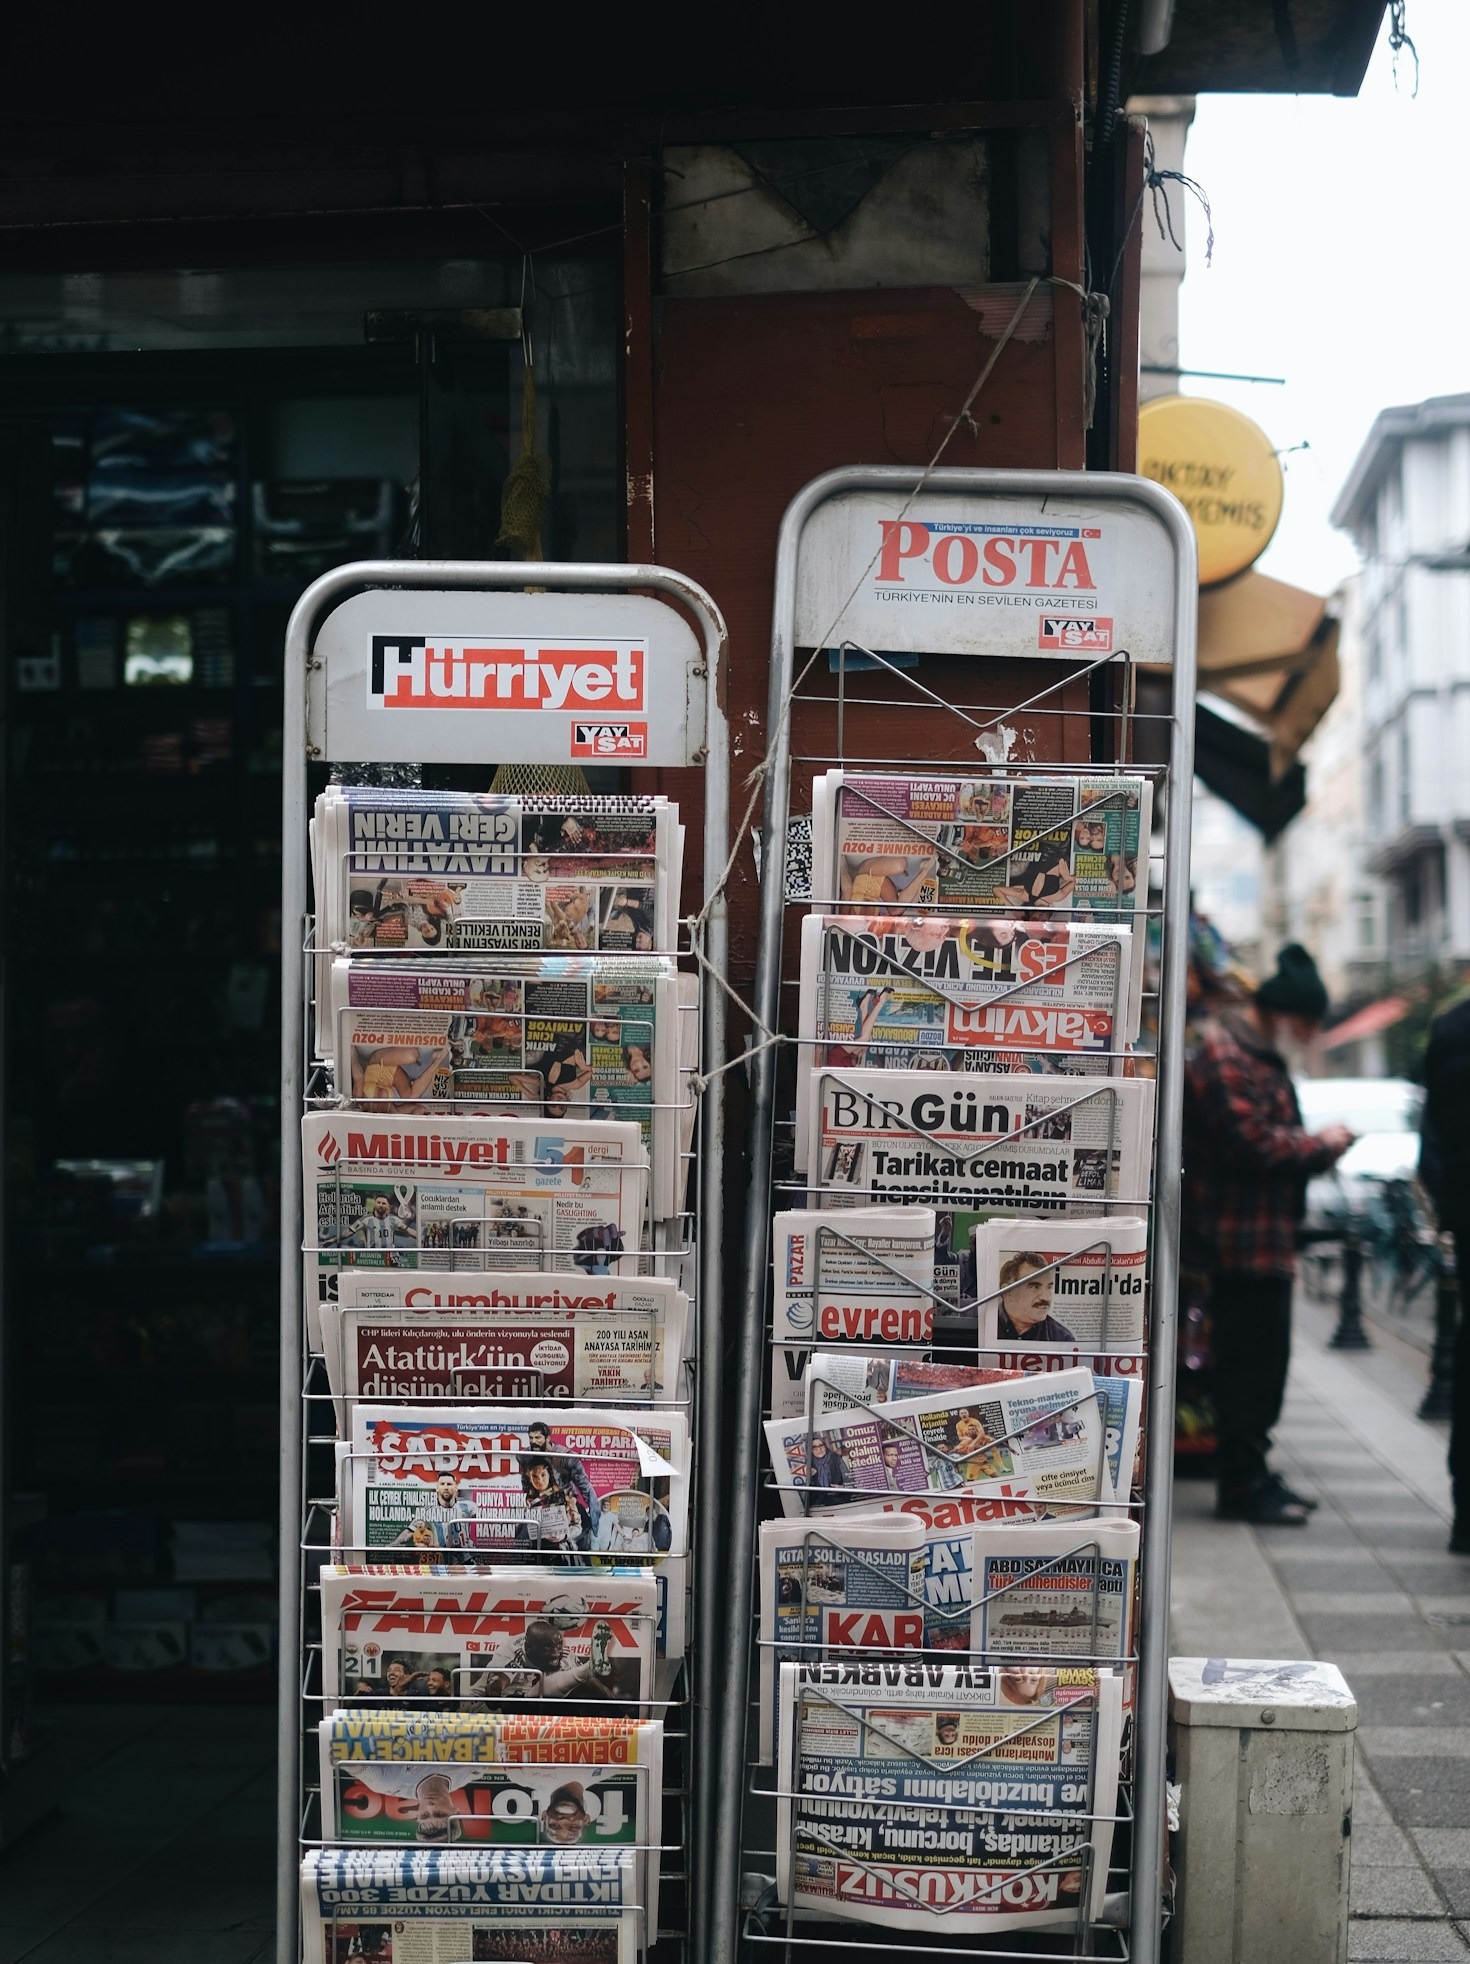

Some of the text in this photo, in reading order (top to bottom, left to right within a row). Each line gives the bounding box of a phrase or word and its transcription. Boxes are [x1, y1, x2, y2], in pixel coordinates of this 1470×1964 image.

[934, 523, 972, 533] Türkiye'yi
[984, 525, 1018, 534] insanları
[1019, 527, 1035, 536] çok
[1035, 528, 1074, 537] seviyoruz
[875, 520, 1097, 590] POSTA
[875, 590, 1098, 609] TÜRKİYE'NİN EN SEVİLEN GAZETESİ
[1046, 620, 1093, 636] YAY
[1064, 630, 1108, 646] SAT
[383, 646, 637, 709] Hürriyet
[578, 726, 625, 743] YAY
[598, 736, 642, 753] SAT
[842, 842, 874, 854] POZU
[354, 840, 515, 874] HAYATIMI
[502, 925, 540, 937] RENKLİ
[953, 1007, 1104, 1047] Takvim
[352, 1032, 385, 1044] POZU
[347, 1132, 511, 1175] Milliyet
[588, 1144, 609, 1155] dergi
[1018, 1145, 1070, 1155] DURUMDALAR
[347, 1166, 416, 1175] BASINDA GÜVEN
[872, 1151, 1068, 1182] Tarikat cemaat
[535, 1175, 562, 1186] gazete
[420, 1203, 467, 1212] anlamlı destek
[556, 1209, 597, 1217] GASLIGHTING
[789, 1234, 805, 1286] PAZAR
[404, 1287, 617, 1320] Cumhuriyet
[361, 1329, 570, 1340] CHP lideri Kılıçdaroğlu, ulu önderin vizyonuyla seslendi
[596, 1330, 649, 1341] 200 YILI AŞAN
[584, 1341, 661, 1352] ANAYASA TARİHİMZ
[362, 1342, 525, 1371] Atatürk'ün
[598, 1369, 621, 1377] YAKIN
[1007, 1389, 1079, 1408] Tekno-markette
[920, 1409, 959, 1422] Hollanda ve
[1008, 1403, 1037, 1417] oyuna
[457, 1424, 490, 1432] Türkiye'nin
[921, 1418, 948, 1430] Arjantin
[846, 1425, 876, 1438] Omuz
[844, 1435, 878, 1448] omuza
[380, 1432, 520, 1473] SABAH
[849, 1445, 880, 1458] olalım
[1060, 1468, 1087, 1479] cinsiyet
[1036, 1481, 1053, 1492] veya
[369, 1490, 379, 1506] İLK
[476, 1523, 516, 1538] HAYRAN
[988, 1560, 1020, 1574] ABD
[884, 1688, 904, 1698] arttı,
[904, 1688, 926, 1699] fahiş
[928, 1691, 954, 1700] Kiralar
[956, 1691, 991, 1703] DİKKAT!
[962, 1735, 991, 1747] doldu
[506, 1740, 628, 1763] DEMBELE
[934, 1746, 954, 1758] icra
[995, 1748, 1055, 1761] Muhtarların
[834, 1758, 853, 1766] Yazık
[857, 1760, 885, 1768] kalacak.
[992, 1764, 1024, 1772] satılacak
[859, 1766, 880, 1775] dolup
[881, 1767, 913, 1776] eşyalarla
[915, 1768, 936, 1777] beyaz
[967, 1769, 1002, 1778] yüzünden
[1025, 1765, 1049, 1773] evinde
[1002, 1772, 1024, 1780] borcu
[1025, 1772, 1065, 1781] dükkanları,
[802, 1773, 1088, 1807] ve buzdolabını satıyor
[878, 1824, 973, 1856] borcunu,
[871, 1852, 896, 1861] bıçak
[897, 1853, 922, 1864] kaldı,
[924, 1854, 965, 1865] geçmişte
[966, 1857, 981, 1866] lafı
[839, 1865, 1059, 1904] KORKUSUZ
[321, 1882, 619, 1903] İKTİDAR YÜZDE 300
[362, 1906, 378, 1915] 85
[380, 1905, 421, 1915] YÜZDE
